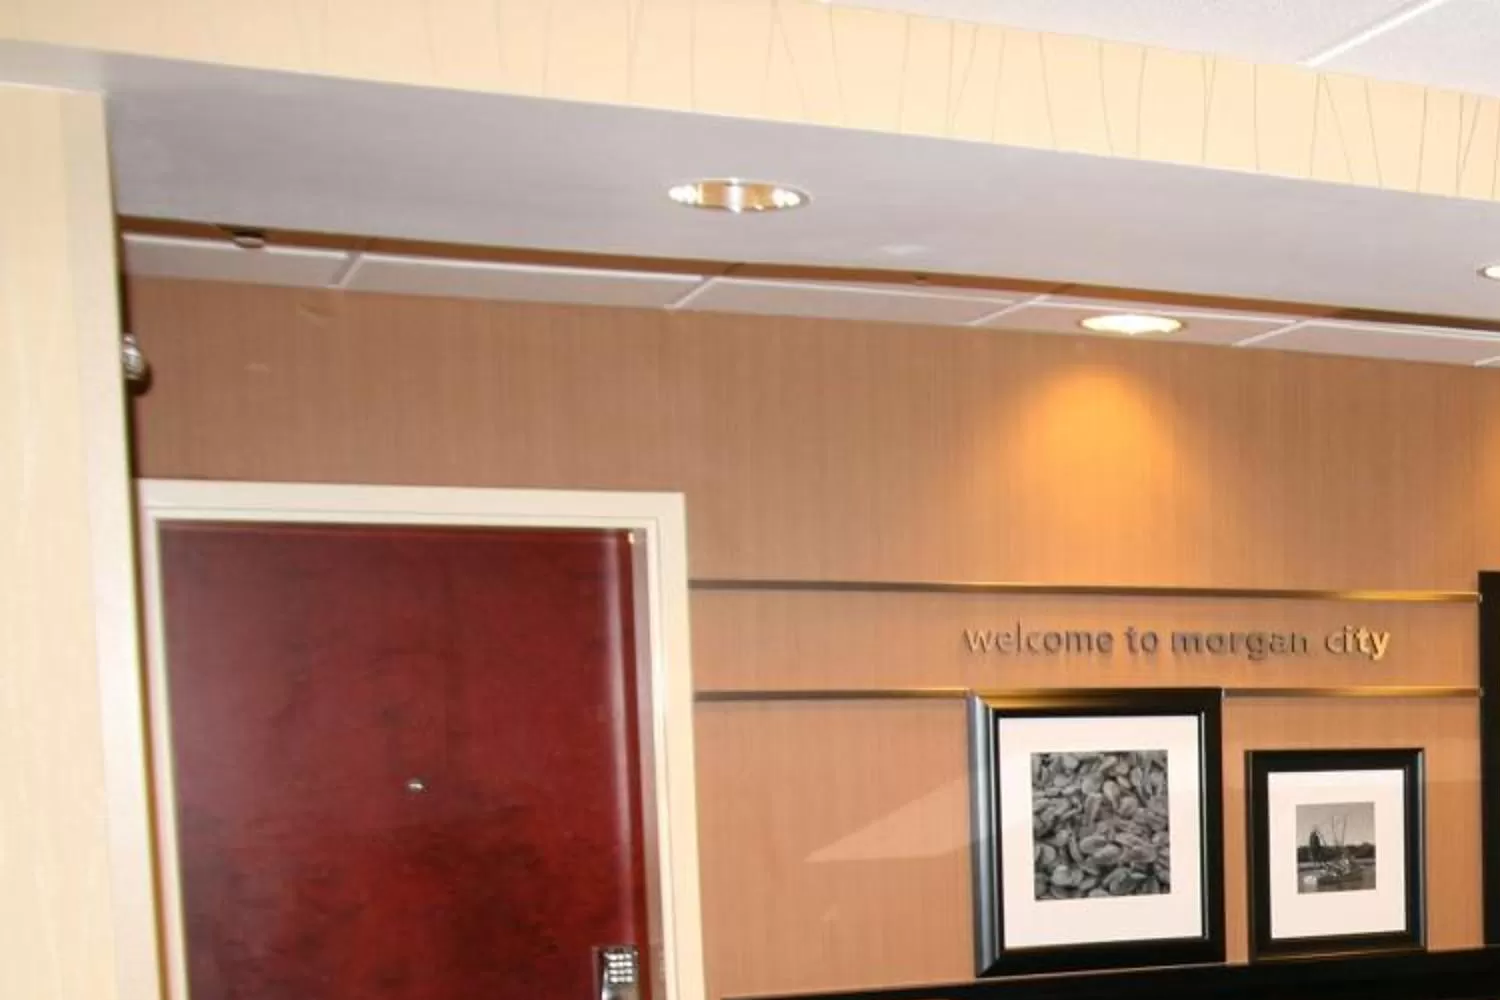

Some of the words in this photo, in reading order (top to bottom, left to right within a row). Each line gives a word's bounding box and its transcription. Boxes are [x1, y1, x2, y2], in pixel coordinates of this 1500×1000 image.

[963, 619, 1115, 655] welcome
[1124, 625, 1160, 654] to
[1171, 630, 1308, 661] morgan
[1324, 624, 1392, 661] city
